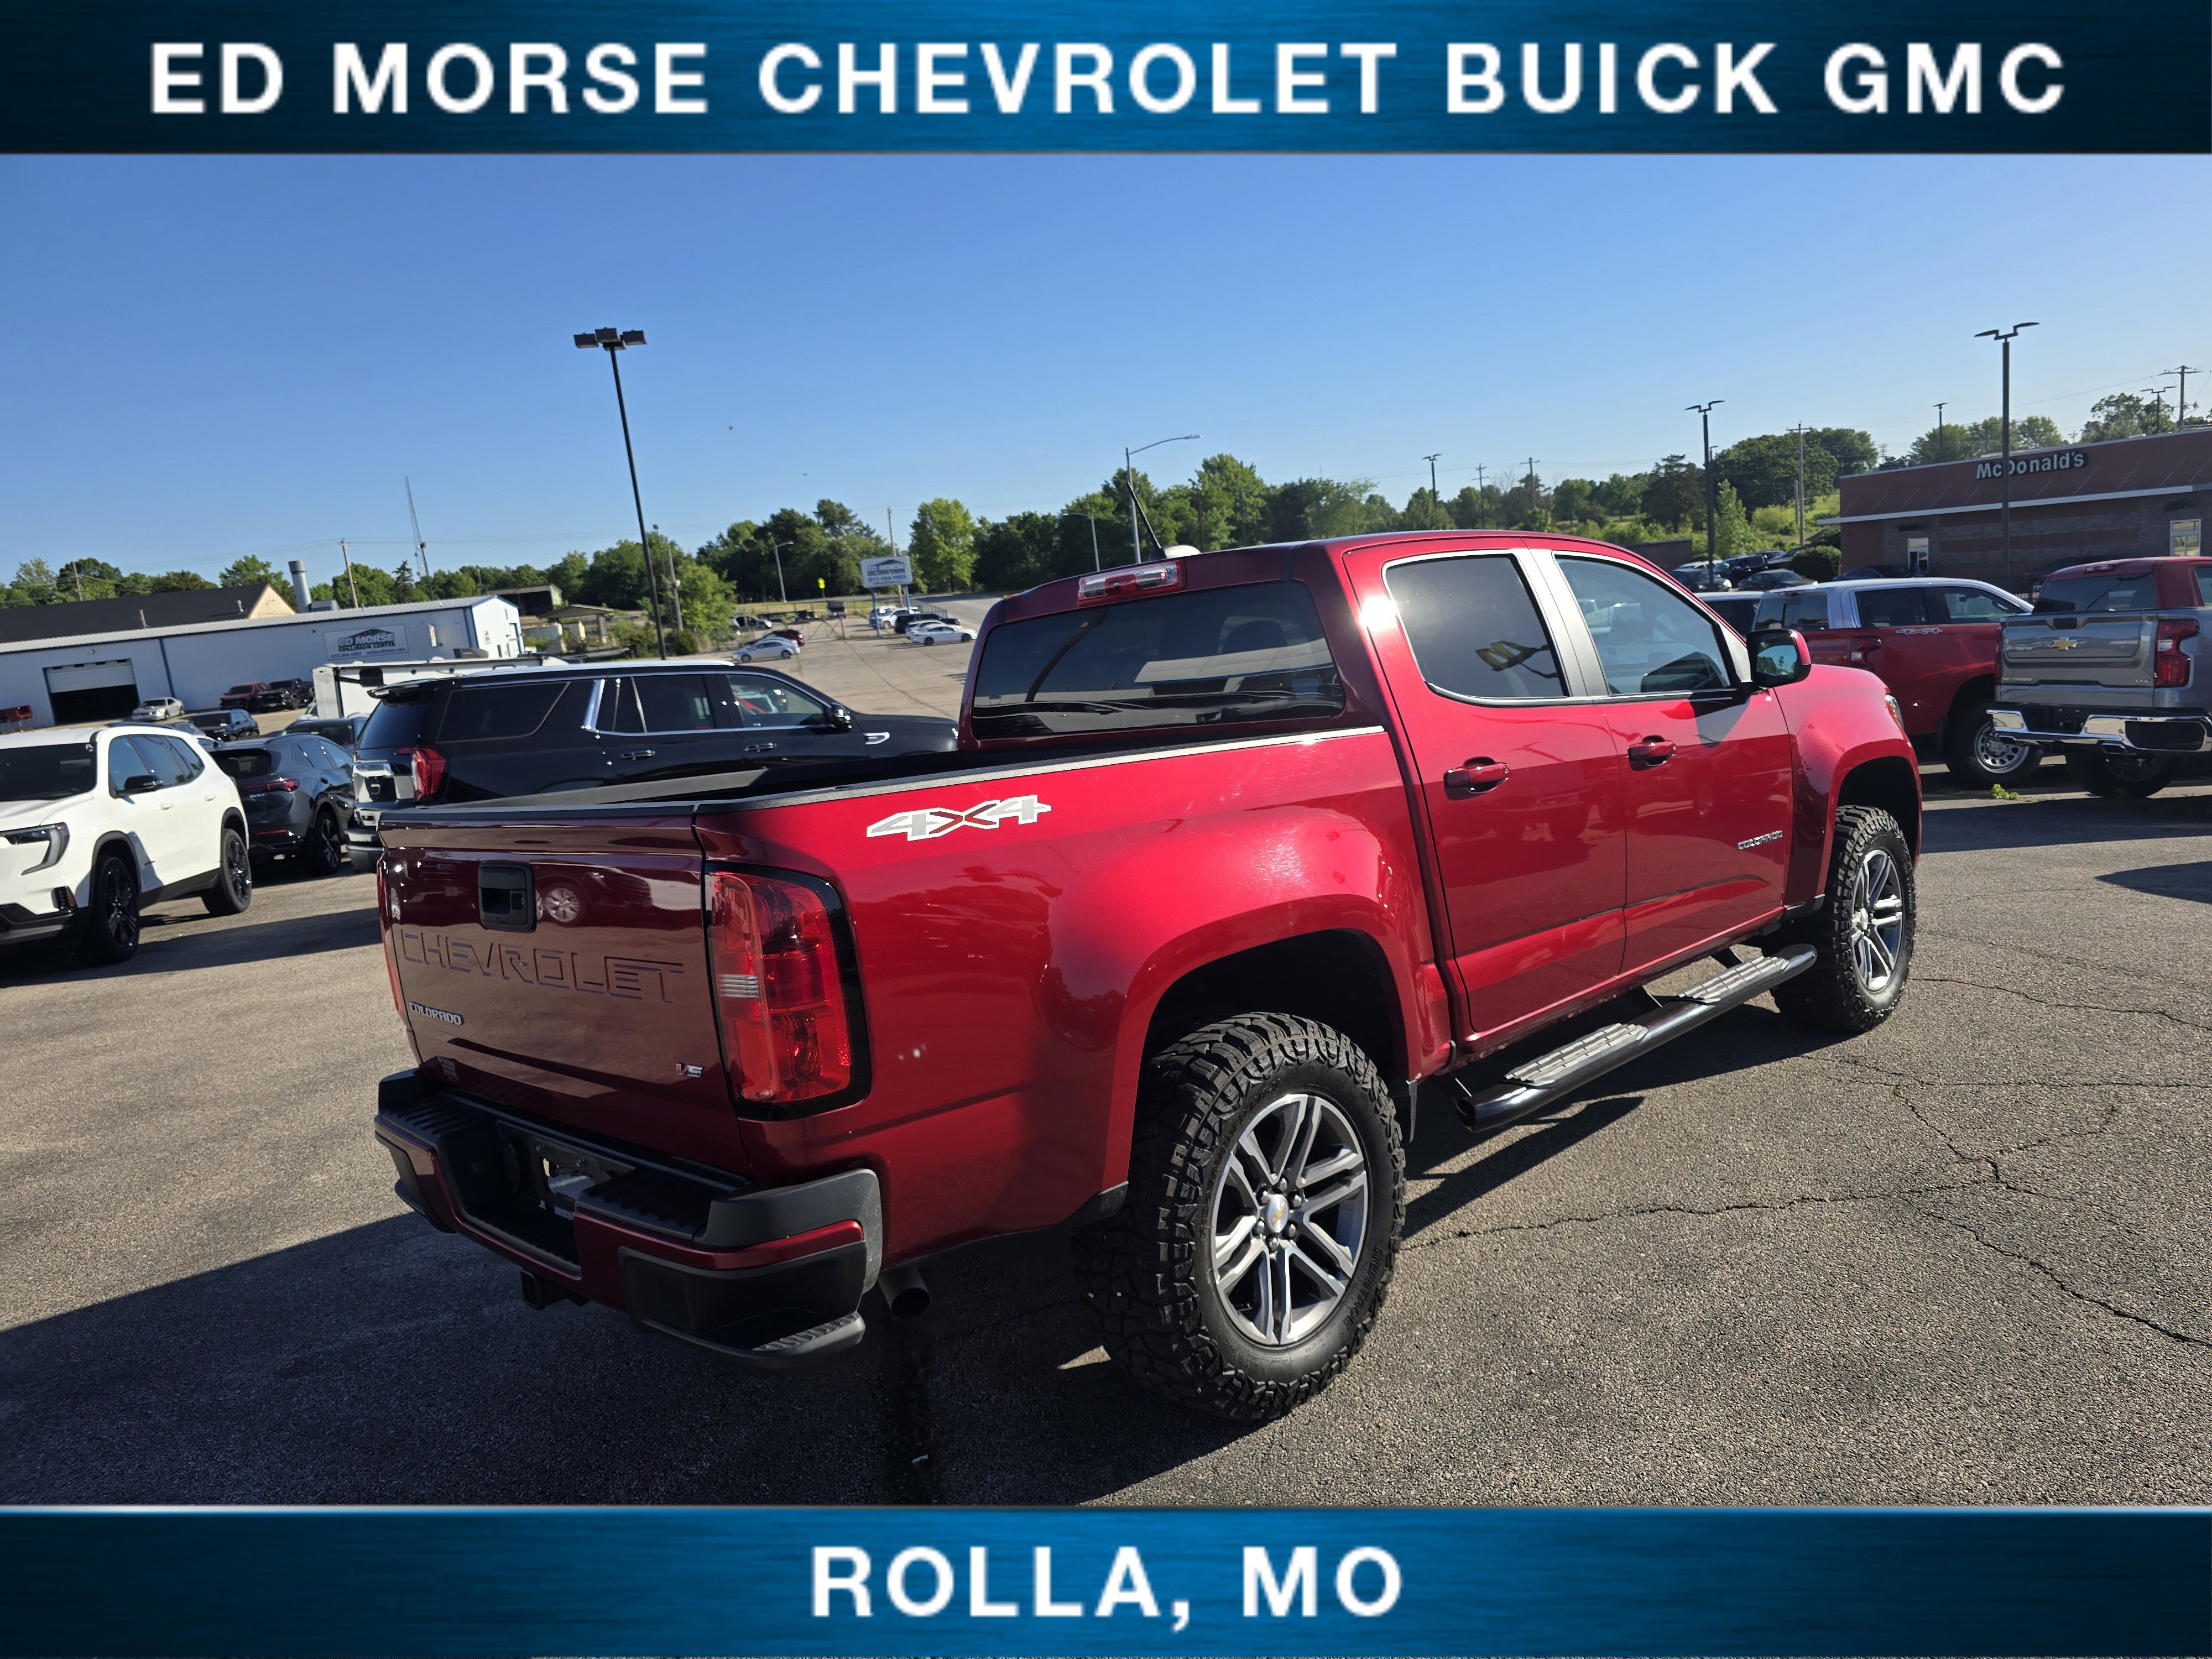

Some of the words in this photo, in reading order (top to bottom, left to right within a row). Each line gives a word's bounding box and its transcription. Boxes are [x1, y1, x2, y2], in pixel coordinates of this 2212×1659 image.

[1976, 452, 2084, 479] McDonald's
[338, 638, 354, 646] ED
[355, 633, 395, 645] MORSE
[400, 928, 685, 1004] CHEVROLET
[409, 1001, 464, 1025] COLORADO
